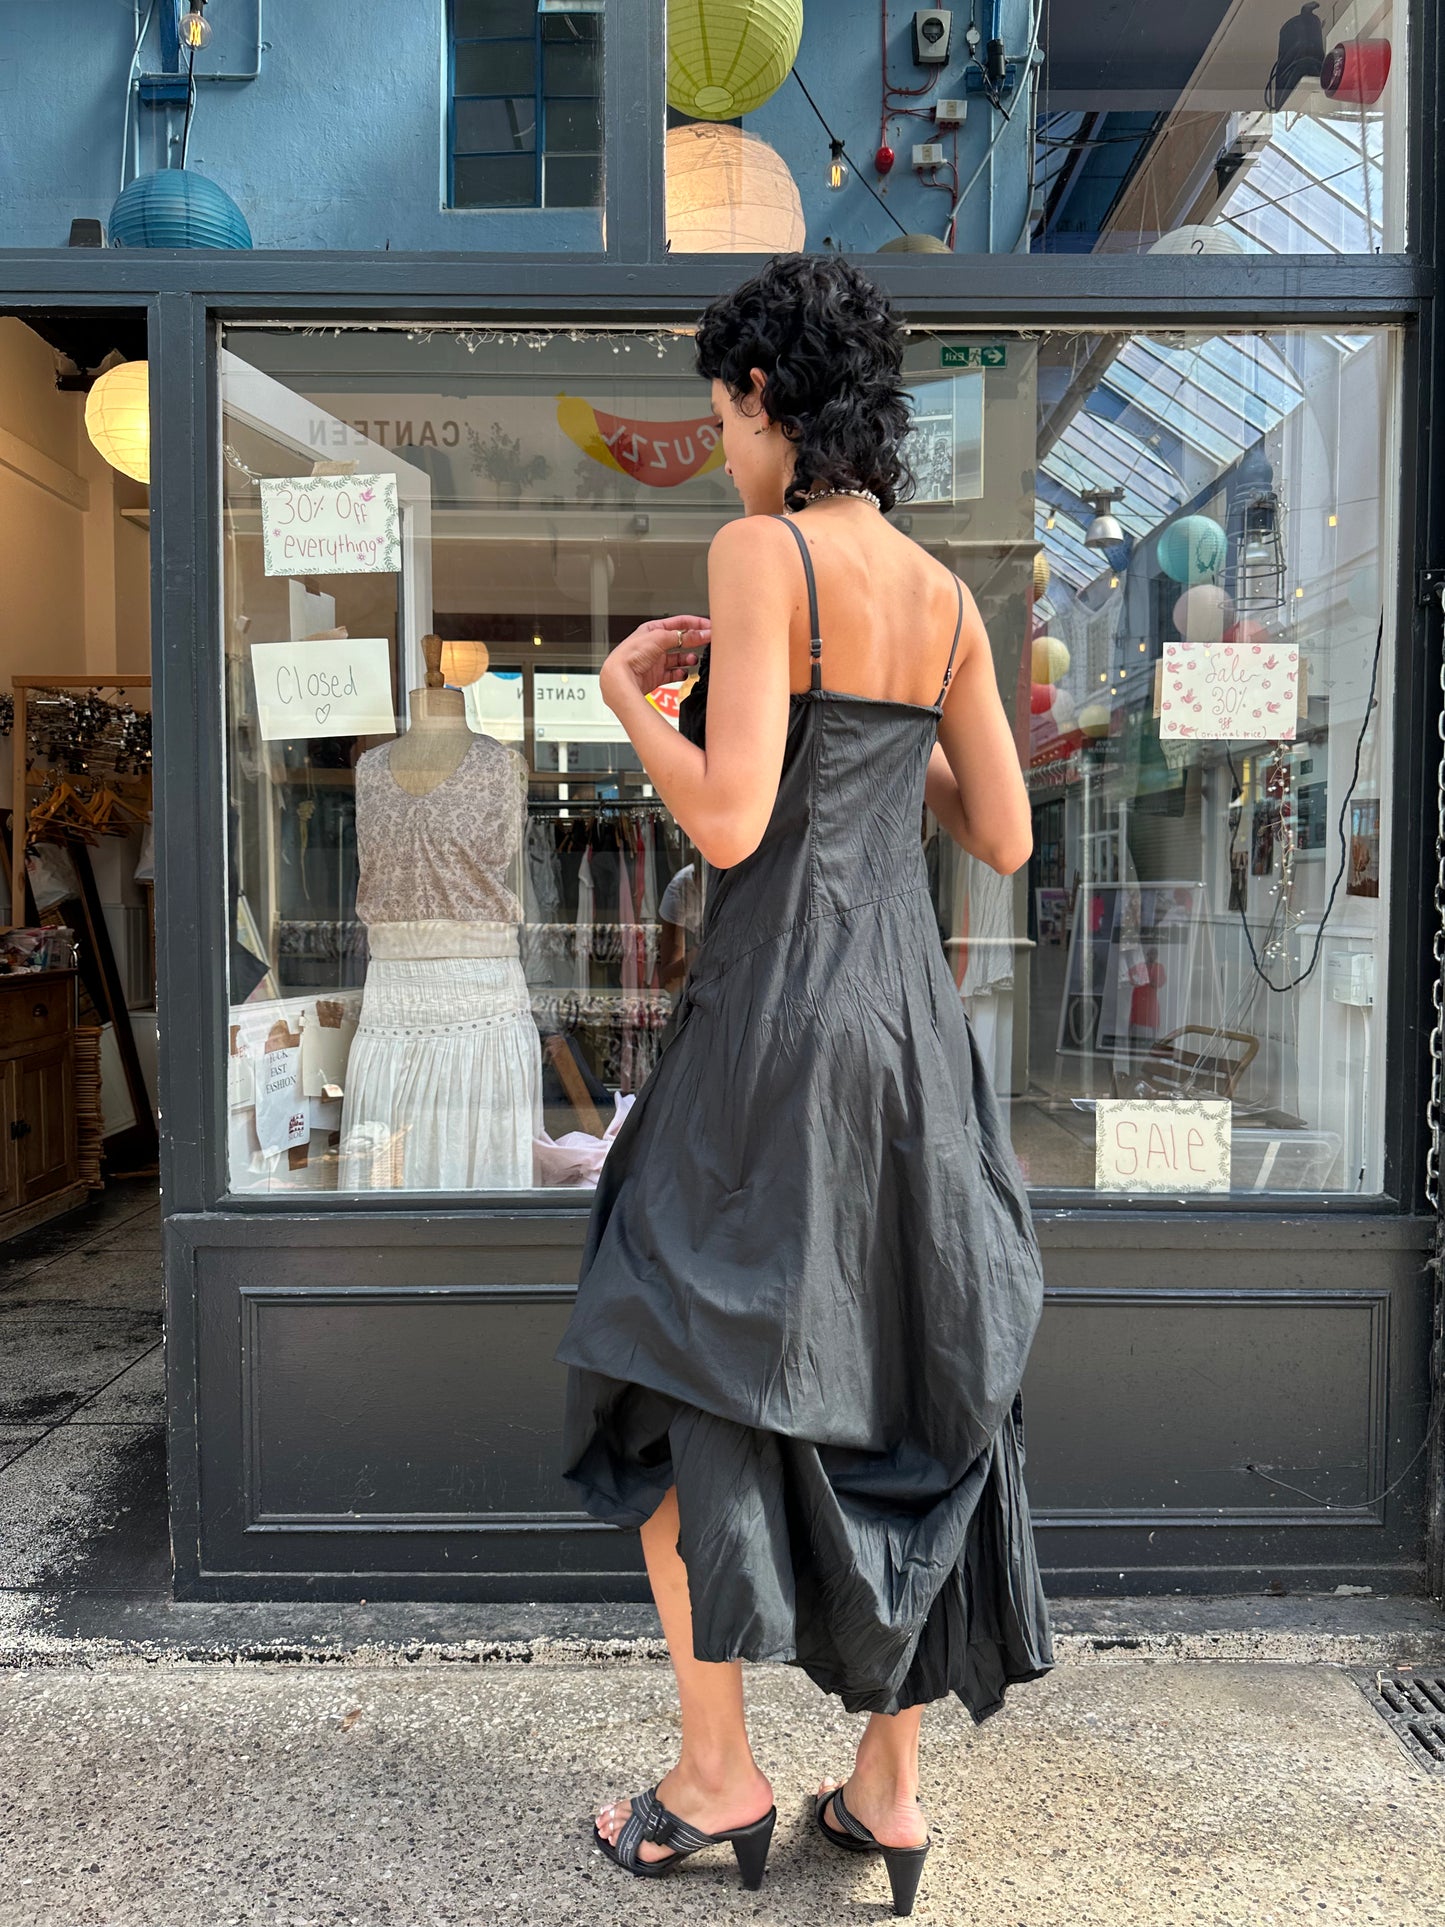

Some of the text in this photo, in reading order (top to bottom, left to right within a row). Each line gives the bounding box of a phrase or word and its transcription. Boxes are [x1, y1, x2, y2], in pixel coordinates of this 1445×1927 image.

[276, 490, 368, 525] 30% Off
[284, 534, 377, 567] everything
[1205, 652, 1259, 684] Sale
[277, 665, 358, 705] Closed
[1212, 686, 1248, 715] 30%
[1219, 717, 1233, 730] off
[266, 1074, 297, 1094] FASHION
[270, 1063, 287, 1077] FAST
